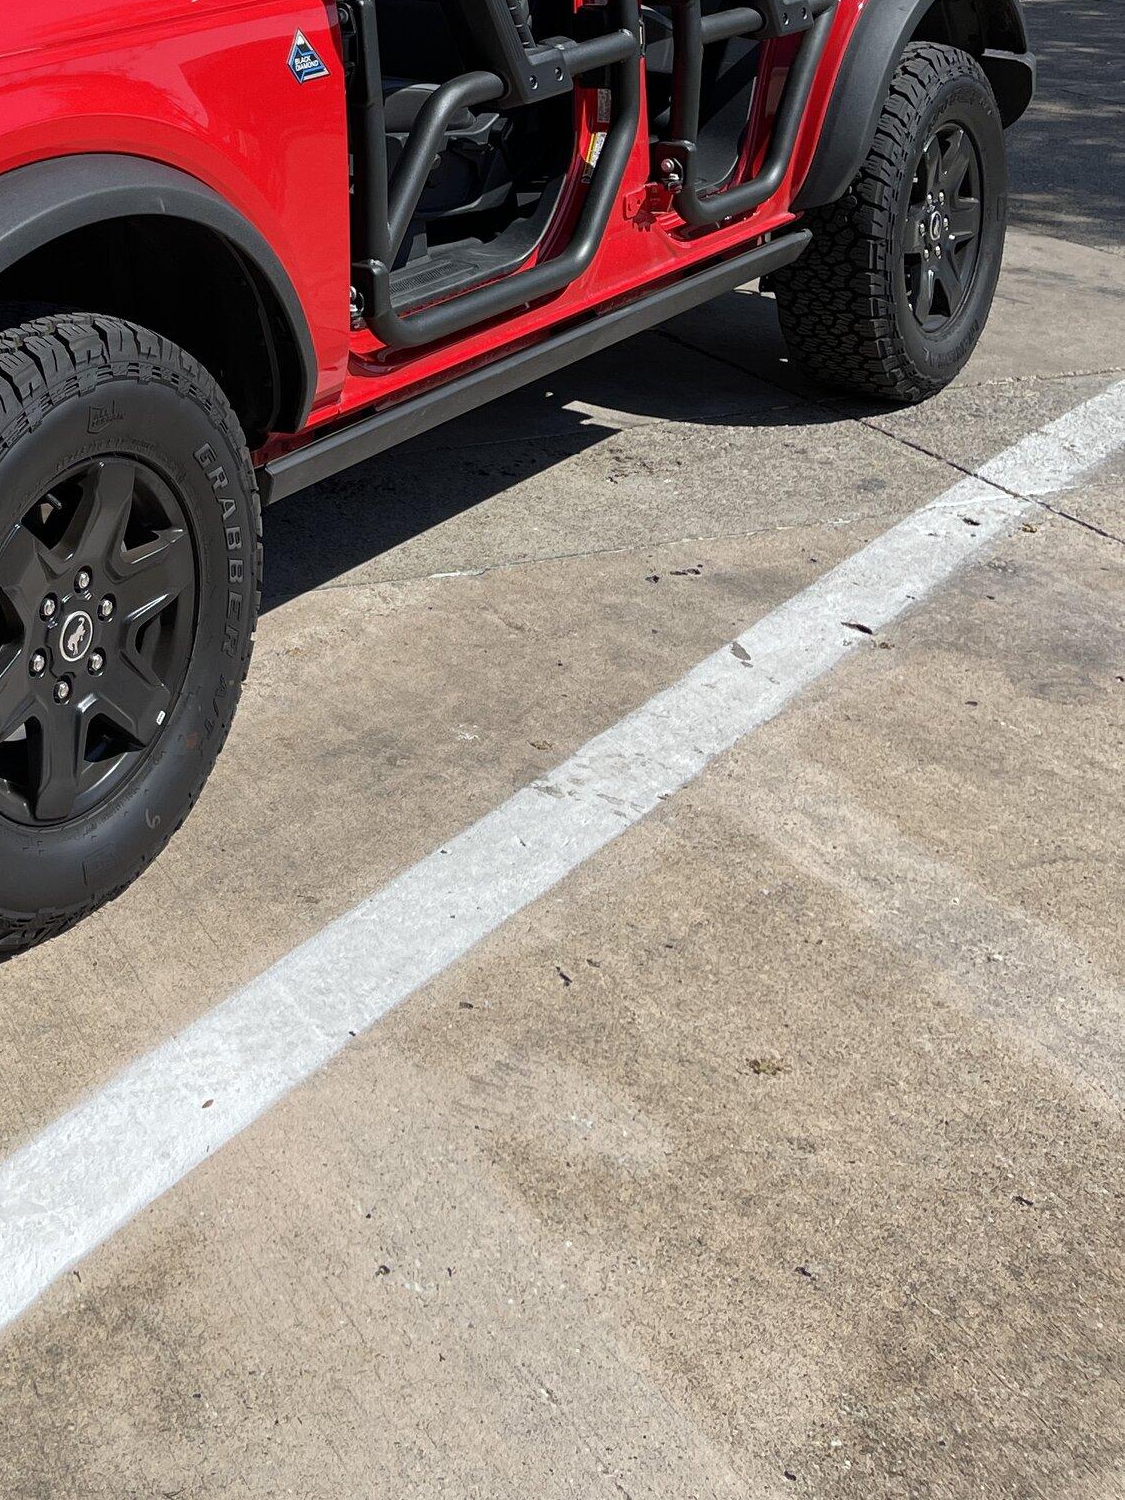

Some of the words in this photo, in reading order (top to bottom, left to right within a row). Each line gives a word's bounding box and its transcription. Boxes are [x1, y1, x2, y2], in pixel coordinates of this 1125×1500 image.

[295, 56, 311, 64] BLACK
[295, 60, 319, 71] DIAMOND
[194, 442, 245, 658] GRABBER
